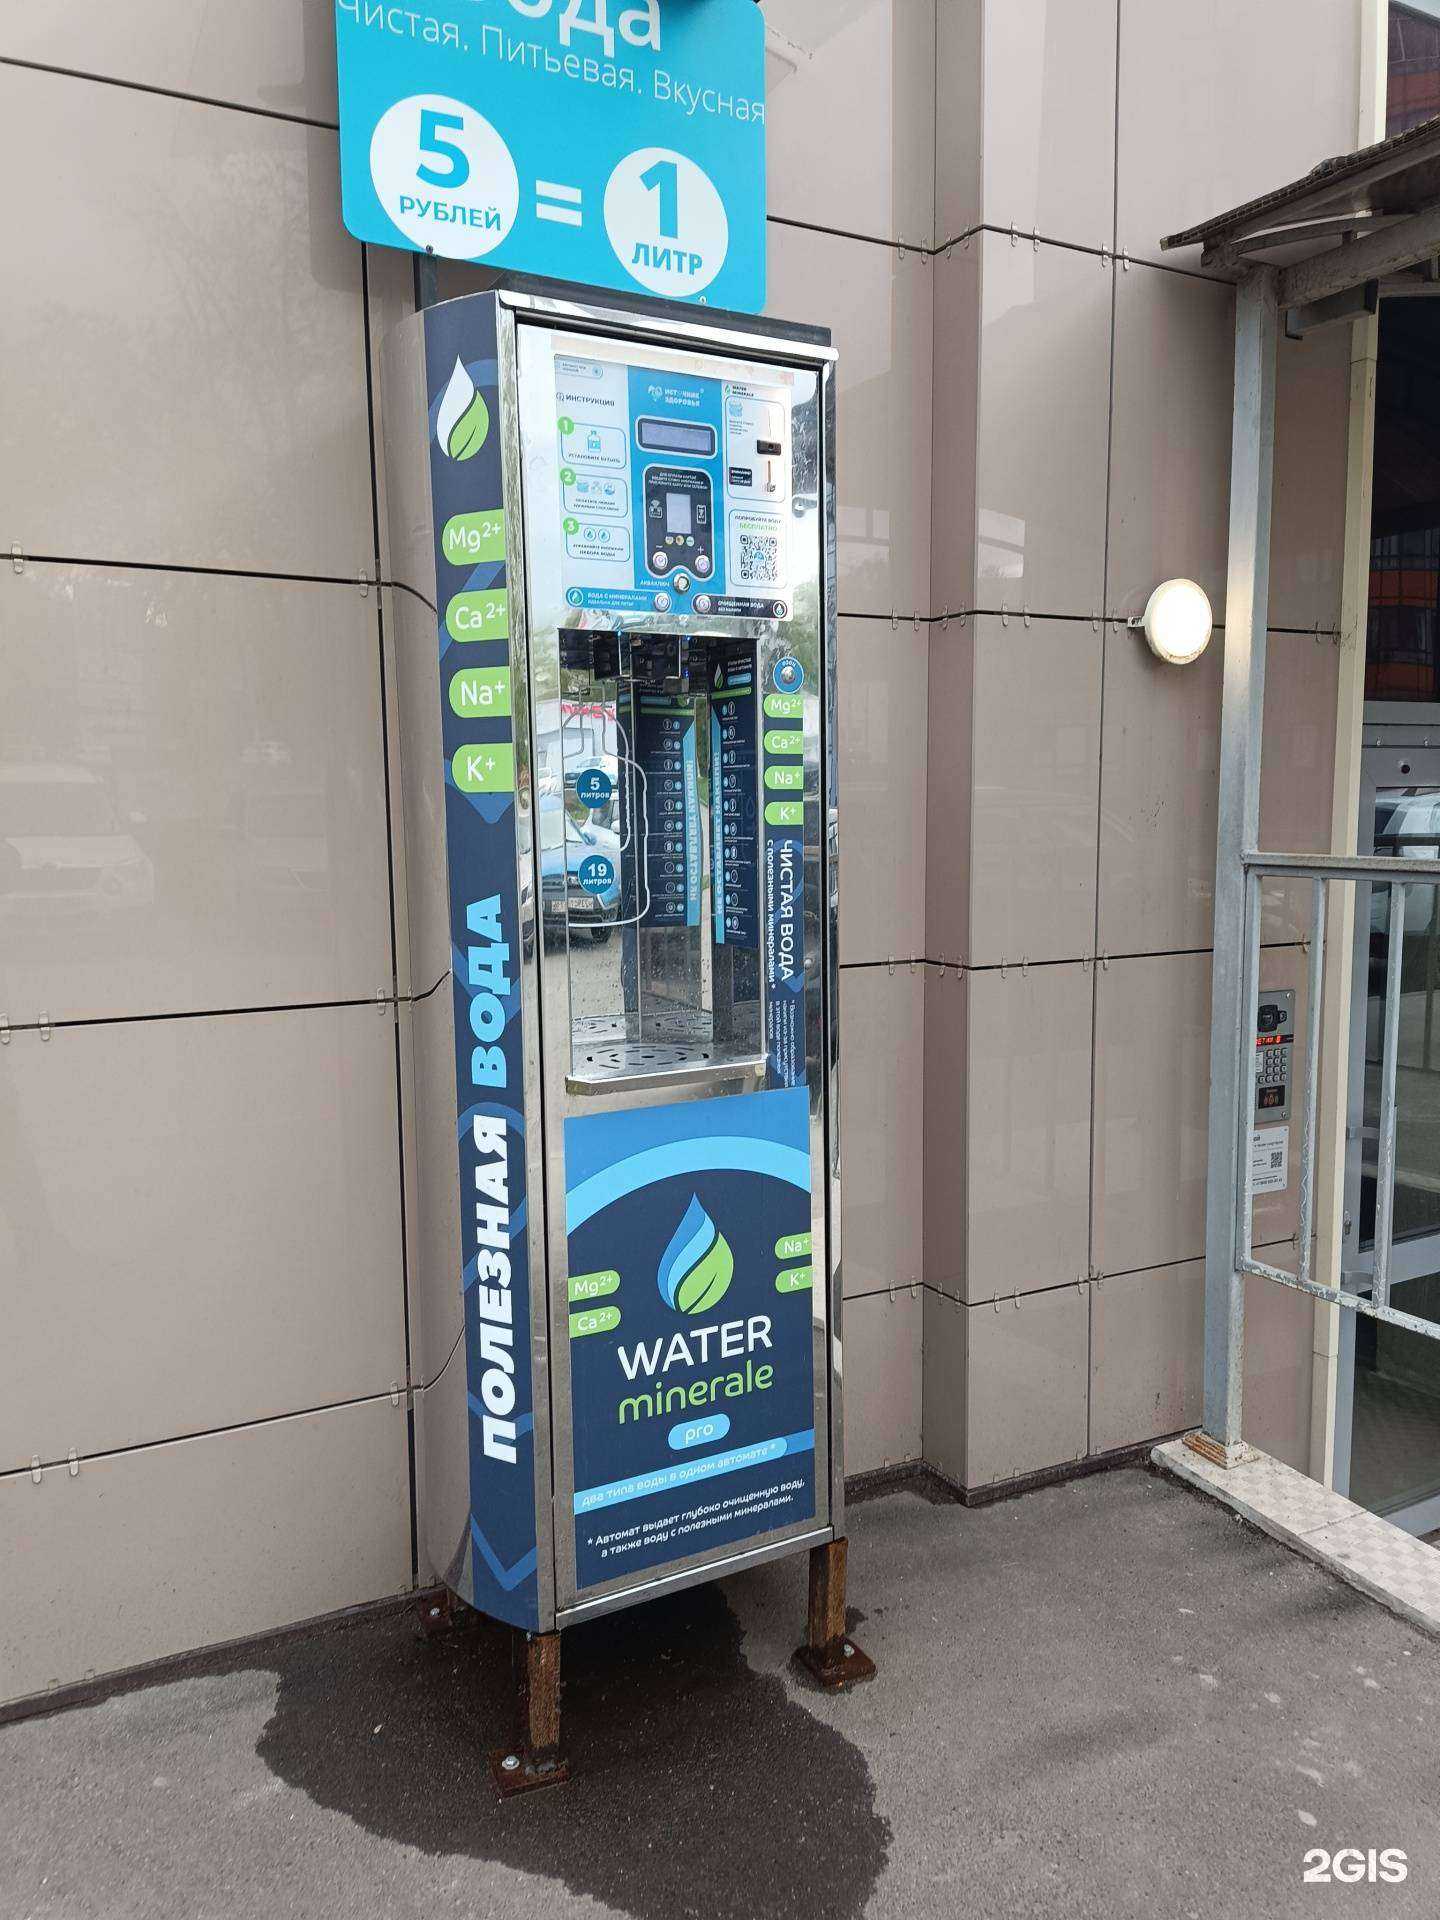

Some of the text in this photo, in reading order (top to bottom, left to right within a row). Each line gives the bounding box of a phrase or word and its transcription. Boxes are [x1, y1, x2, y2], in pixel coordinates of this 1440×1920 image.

[482, 24, 642, 95] Питьевая.
[654, 69, 766, 125] Вкусная
[415, 108, 470, 189] 5
[399, 194, 502, 232] РУБЛЕЙ
[638, 159, 679, 240] 1
[631, 242, 703, 276] ЛИТР
[590, 777, 600, 790] 5
[588, 864, 607, 877] 19
[766, 850, 774, 912] полезными
[778, 839, 794, 981] ЧИСТАЯ ВОДА
[766, 913, 776, 983] минералами
[466, 893, 518, 1465] ПОЛЕЗНАЯ ВОДА
[617, 1315, 773, 1381] WATER
[618, 1359, 774, 1424] minerale
[684, 1423, 714, 1447] pro
[637, 1475, 667, 1490] воды
[595, 1525, 641, 1546] Автомат
[642, 1514, 680, 1533] выдает
[681, 1502, 721, 1520] глубоко
[722, 1485, 779, 1509] очищенную
[610, 1539, 642, 1555] также
[644, 1531, 669, 1545] воду
[678, 1511, 733, 1535] полезными
[734, 1494, 794, 1518] минералами.
